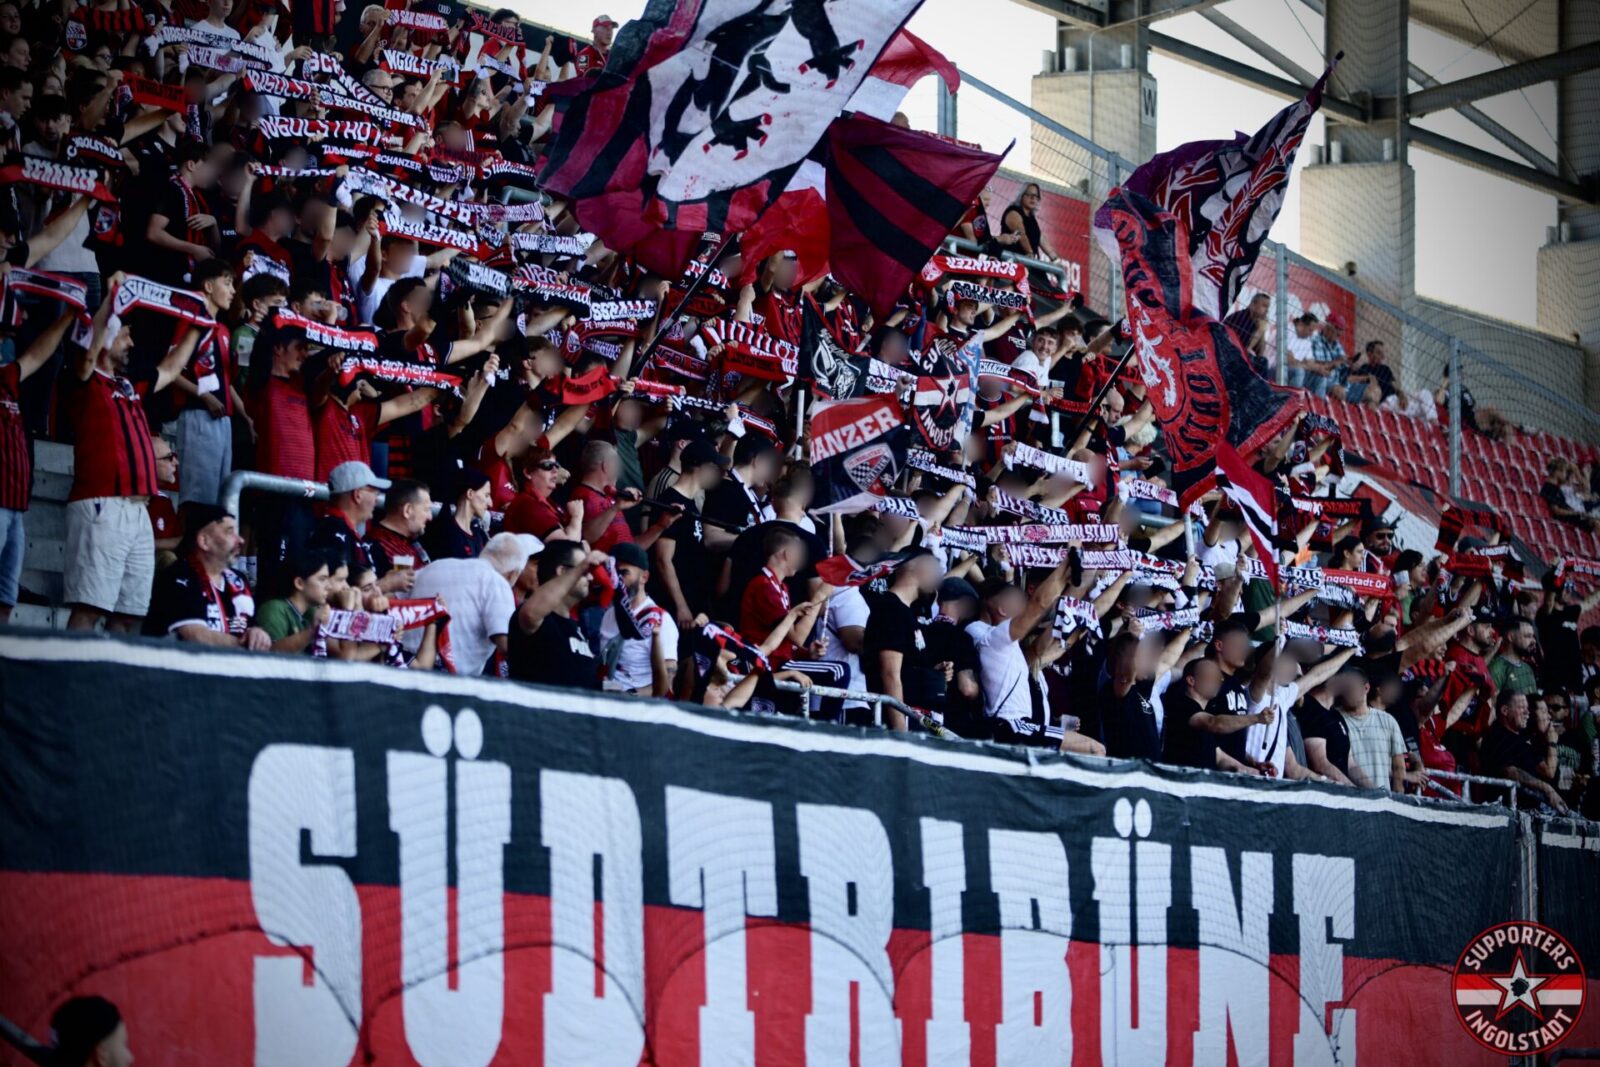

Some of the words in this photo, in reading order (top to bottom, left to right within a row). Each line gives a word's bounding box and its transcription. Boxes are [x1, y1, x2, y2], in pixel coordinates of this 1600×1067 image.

[1143, 87, 1157, 117] W
[953, 281, 1027, 308] SCHANZER
[1050, 523, 1120, 543] INGOLSTADT
[1006, 543, 1061, 568] WEHEN
[248, 704, 1356, 1067] SÜDTRIBÜNE
